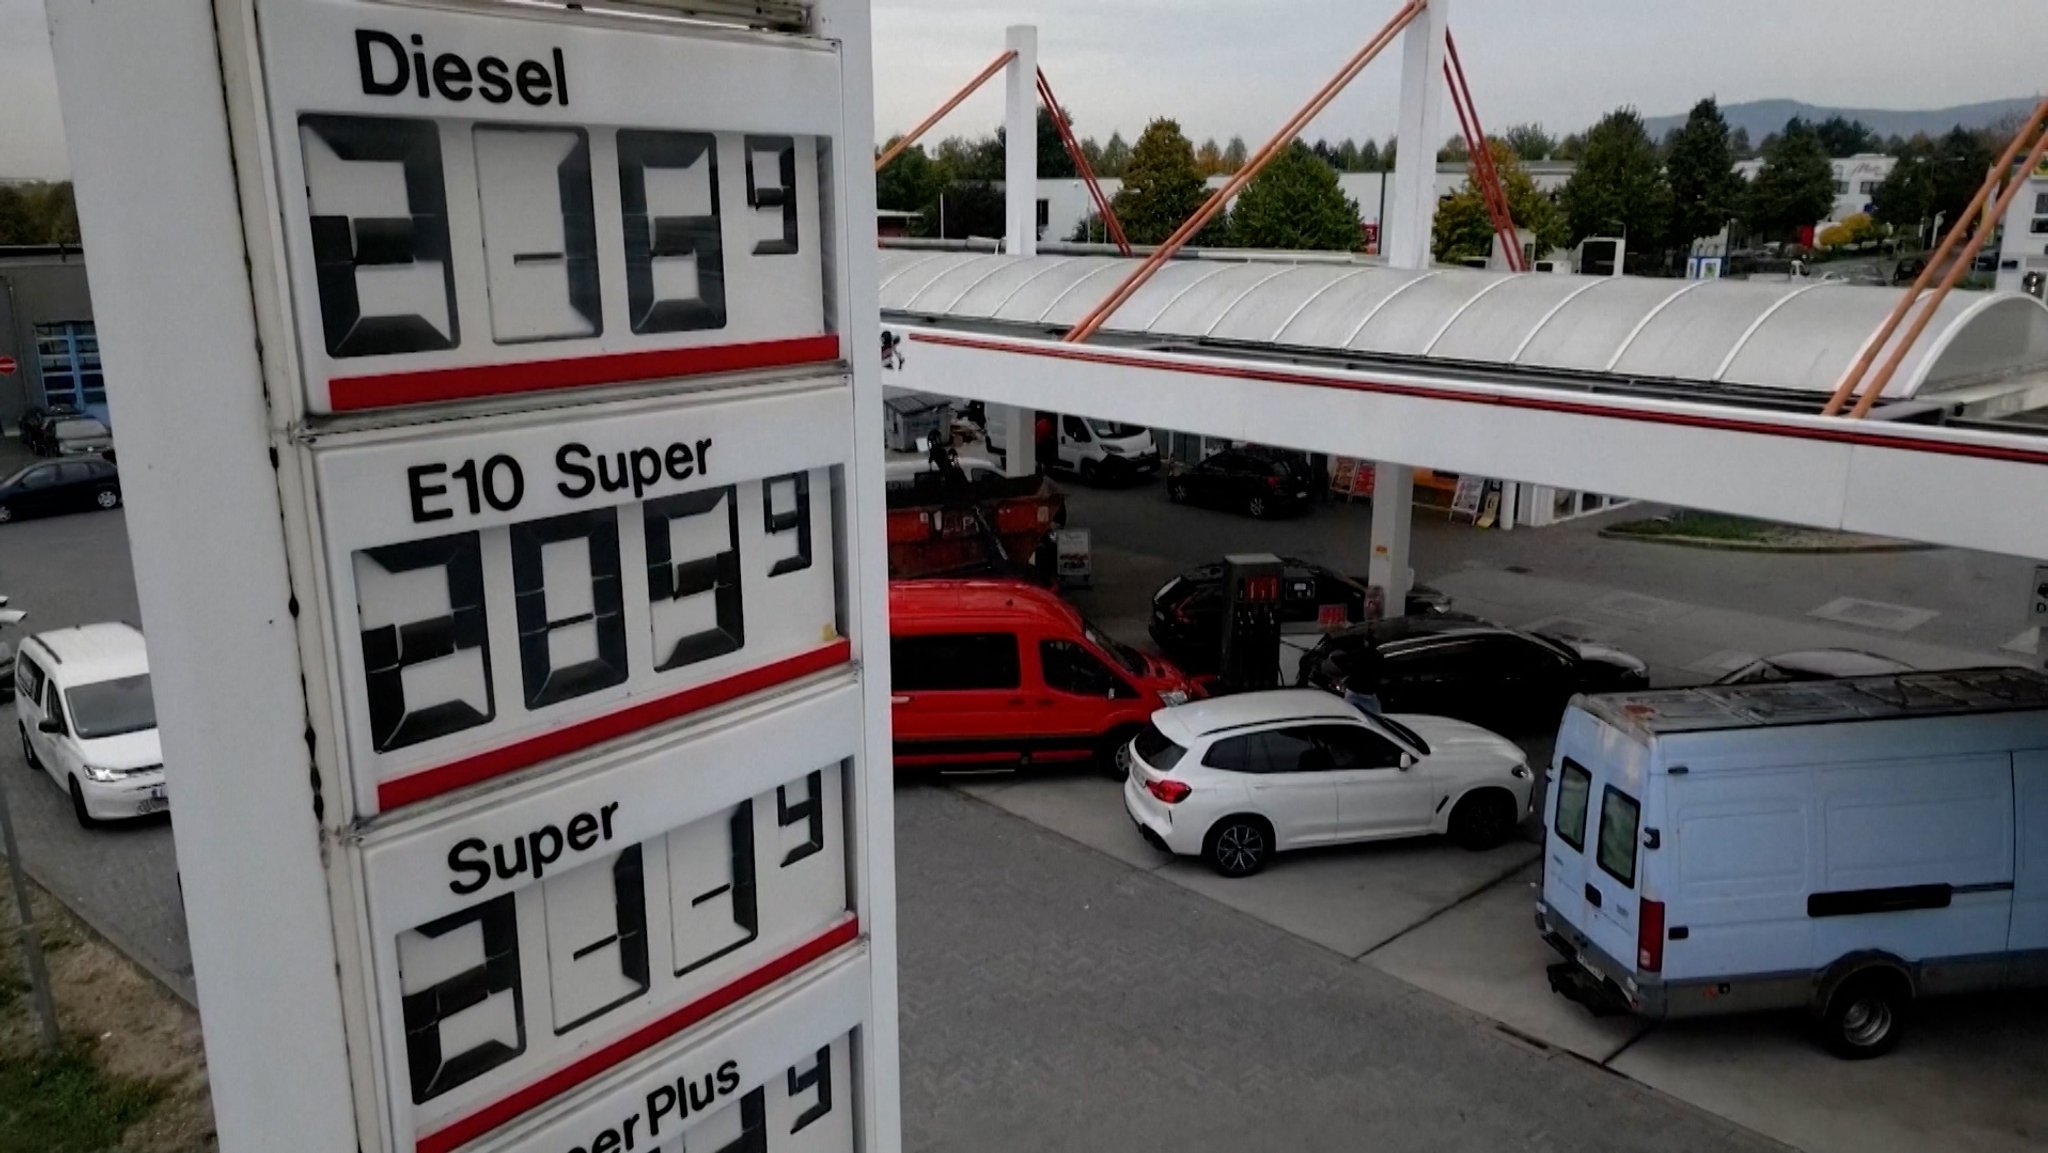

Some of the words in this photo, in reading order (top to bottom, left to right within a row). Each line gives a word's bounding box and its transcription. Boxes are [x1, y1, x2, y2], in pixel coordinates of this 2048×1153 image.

[354, 28, 570, 107] Diesel
[408, 454, 525, 525] E10
[555, 436, 713, 499] Super
[447, 800, 619, 895] Super
[646, 1059, 741, 1137] Plus
